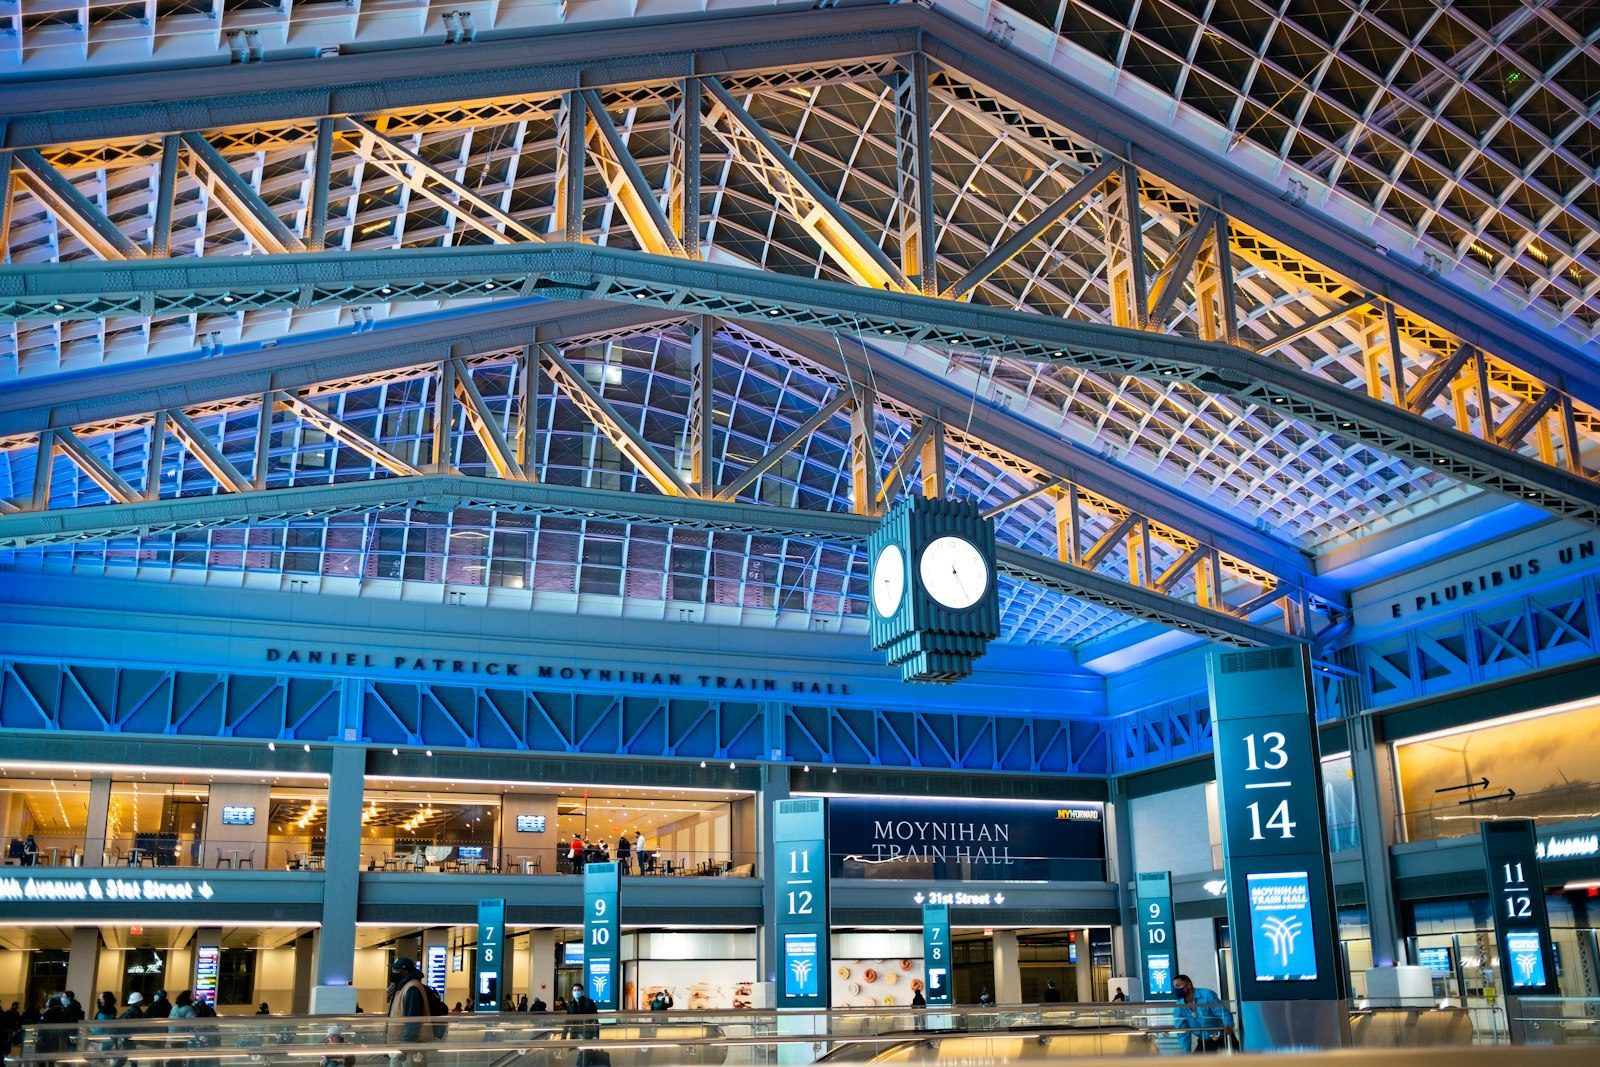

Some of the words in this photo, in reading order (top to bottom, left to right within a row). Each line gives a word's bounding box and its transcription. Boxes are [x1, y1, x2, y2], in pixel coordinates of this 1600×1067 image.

[1391, 604, 1401, 618] E
[1415, 559, 1540, 611] PLURIBUS
[265, 648, 374, 668] DANIEL
[395, 656, 519, 677] PATRICK
[538, 665, 681, 684] MOYNIHAN
[699, 675, 777, 692] TRAIN
[792, 681, 851, 696] HALL
[1242, 731, 1289, 771] 13
[1246, 799, 1297, 841] 14
[873, 820, 1011, 843] MOYNIHAN
[789, 850, 810, 874] 11
[872, 843, 947, 864] TRAIN
[955, 846, 1015, 865] HALL
[1503, 862, 1525, 883] 11
[24, 877, 87, 900] Avenue
[105, 878, 141, 900] 31st
[143, 879, 193, 900] Street
[929, 891, 954, 904] 31st
[955, 891, 991, 905] Street
[1251, 885, 1306, 897] MOYNIHAN
[1251, 895, 1281, 904] TRAIN
[1282, 893, 1308, 903] HALL
[595, 898, 606, 916] 9
[787, 890, 813, 915] 12
[1149, 903, 1160, 918] 9
[1506, 896, 1533, 918] 12
[486, 926, 494, 940] 7
[591, 926, 610, 945] 10
[932, 927, 940, 940] 7
[1148, 928, 1166, 944] 10
[484, 948, 494, 962] 8
[932, 948, 941, 960] 8
